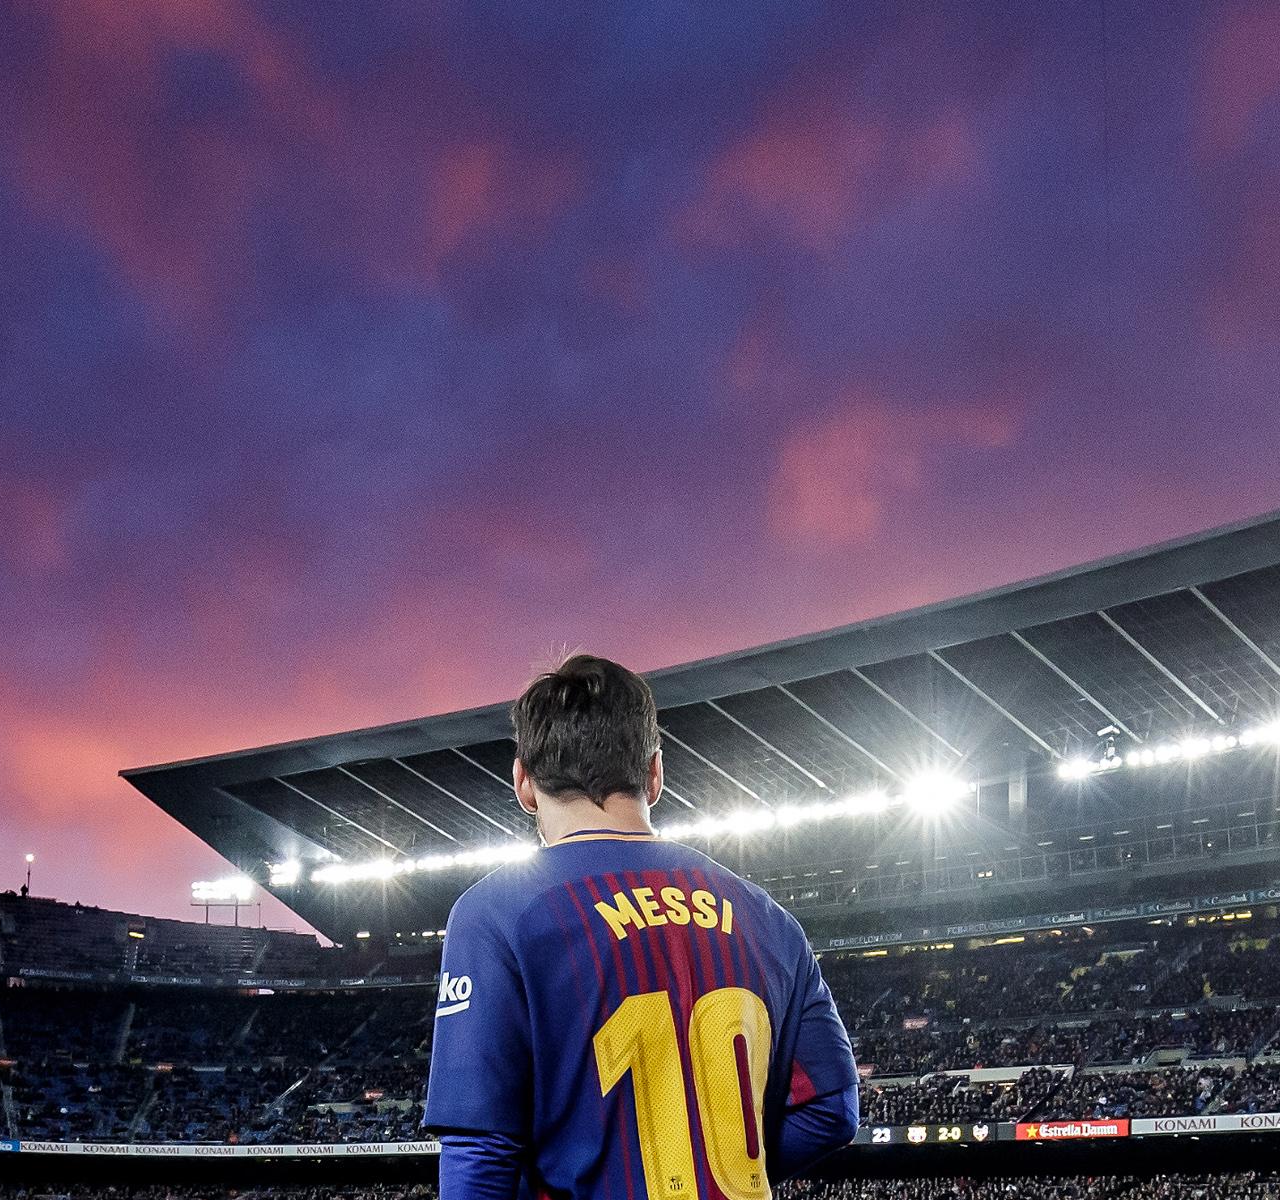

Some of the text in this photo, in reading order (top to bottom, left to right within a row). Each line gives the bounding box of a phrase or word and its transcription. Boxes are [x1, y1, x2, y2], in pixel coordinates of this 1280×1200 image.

[594, 886, 734, 940] MESSI
[439, 972, 473, 1002] ko
[1039, 1122, 1118, 1137] Estrella Damm
[1154, 1117, 1217, 1132] KONAMI
[872, 1128, 891, 1142] 23
[938, 1126, 961, 1142] 2-0
[20, 1142, 437, 1156] KONAMI KONAMI KONAMI KONAMI KONAMI KONAMI KONAMI KONAMI
